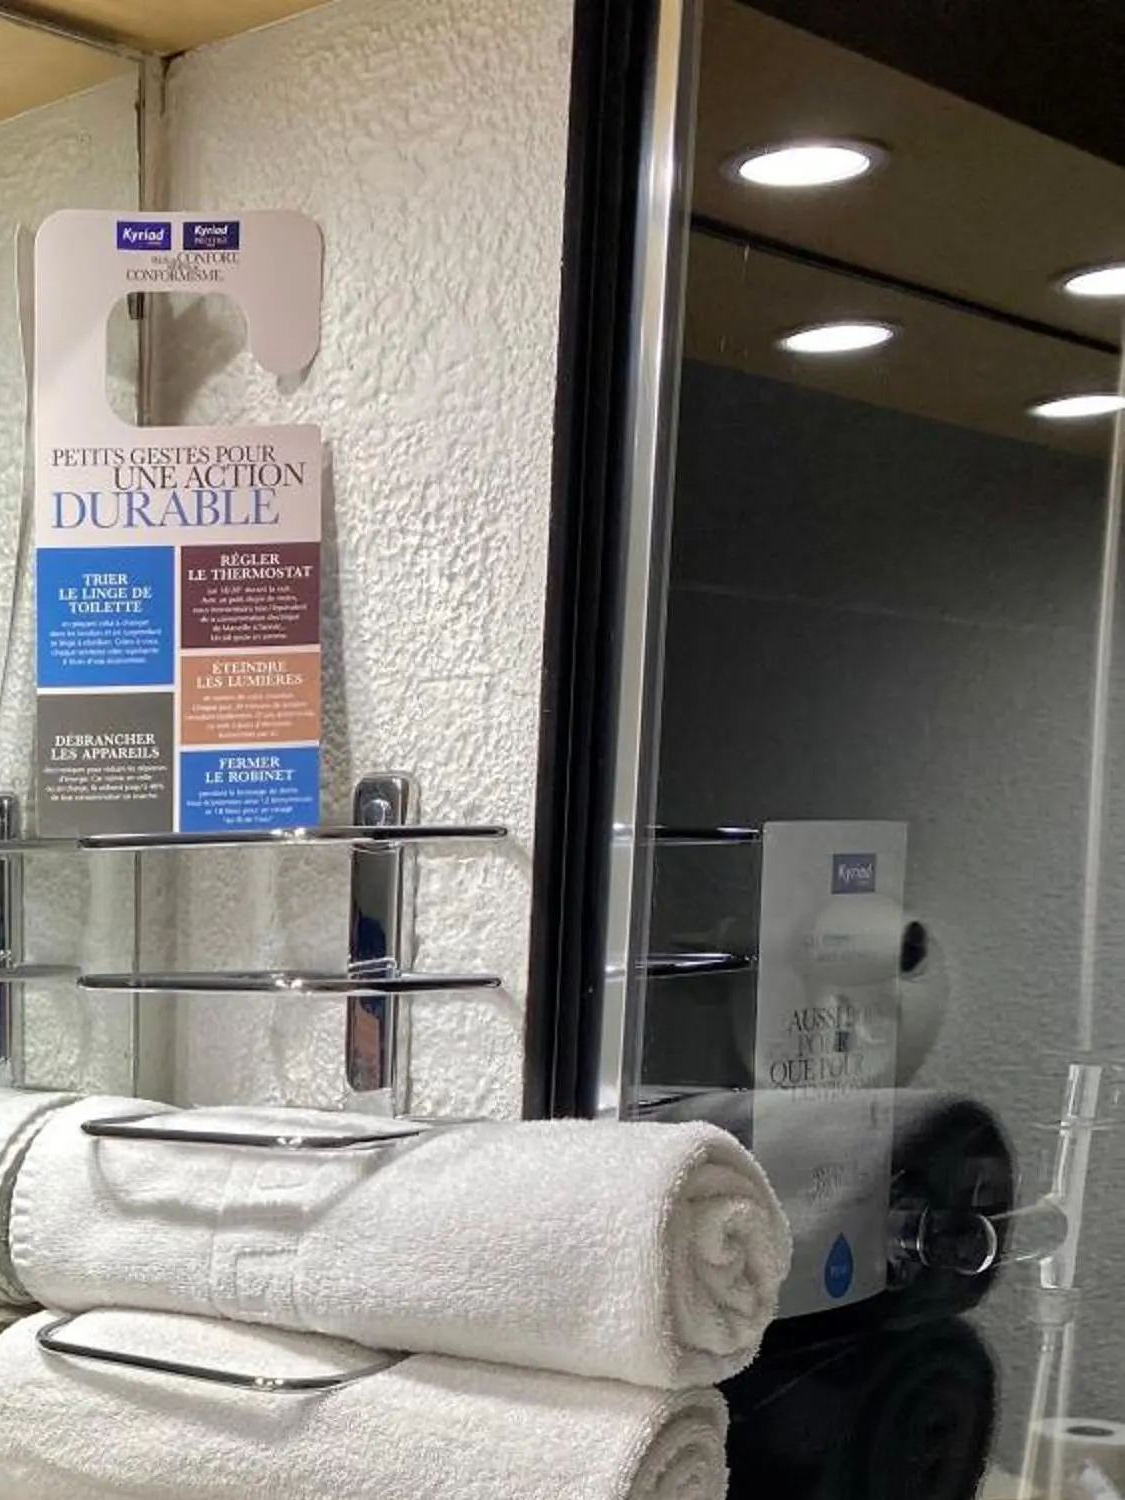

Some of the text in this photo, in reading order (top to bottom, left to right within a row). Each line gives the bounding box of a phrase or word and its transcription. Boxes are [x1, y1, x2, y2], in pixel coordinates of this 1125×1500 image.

[122, 227, 165, 244] Kyriad
[194, 225, 228, 237] Kyriad
[51, 444, 277, 467] PETITS GESTES POUR
[113, 461, 306, 490] UNE ACTION
[51, 487, 280, 529] DURABLE
[83, 573, 129, 586] TRIER
[188, 565, 313, 581] LE THERMOSTAT
[58, 586, 153, 601] LE LINGE DE
[68, 601, 144, 614] TOILETTE
[196, 675, 223, 689] LES
[50, 747, 160, 761] LES APPAREILS
[218, 756, 281, 770] FERMER
[205, 769, 295, 784] LE ROBINET
